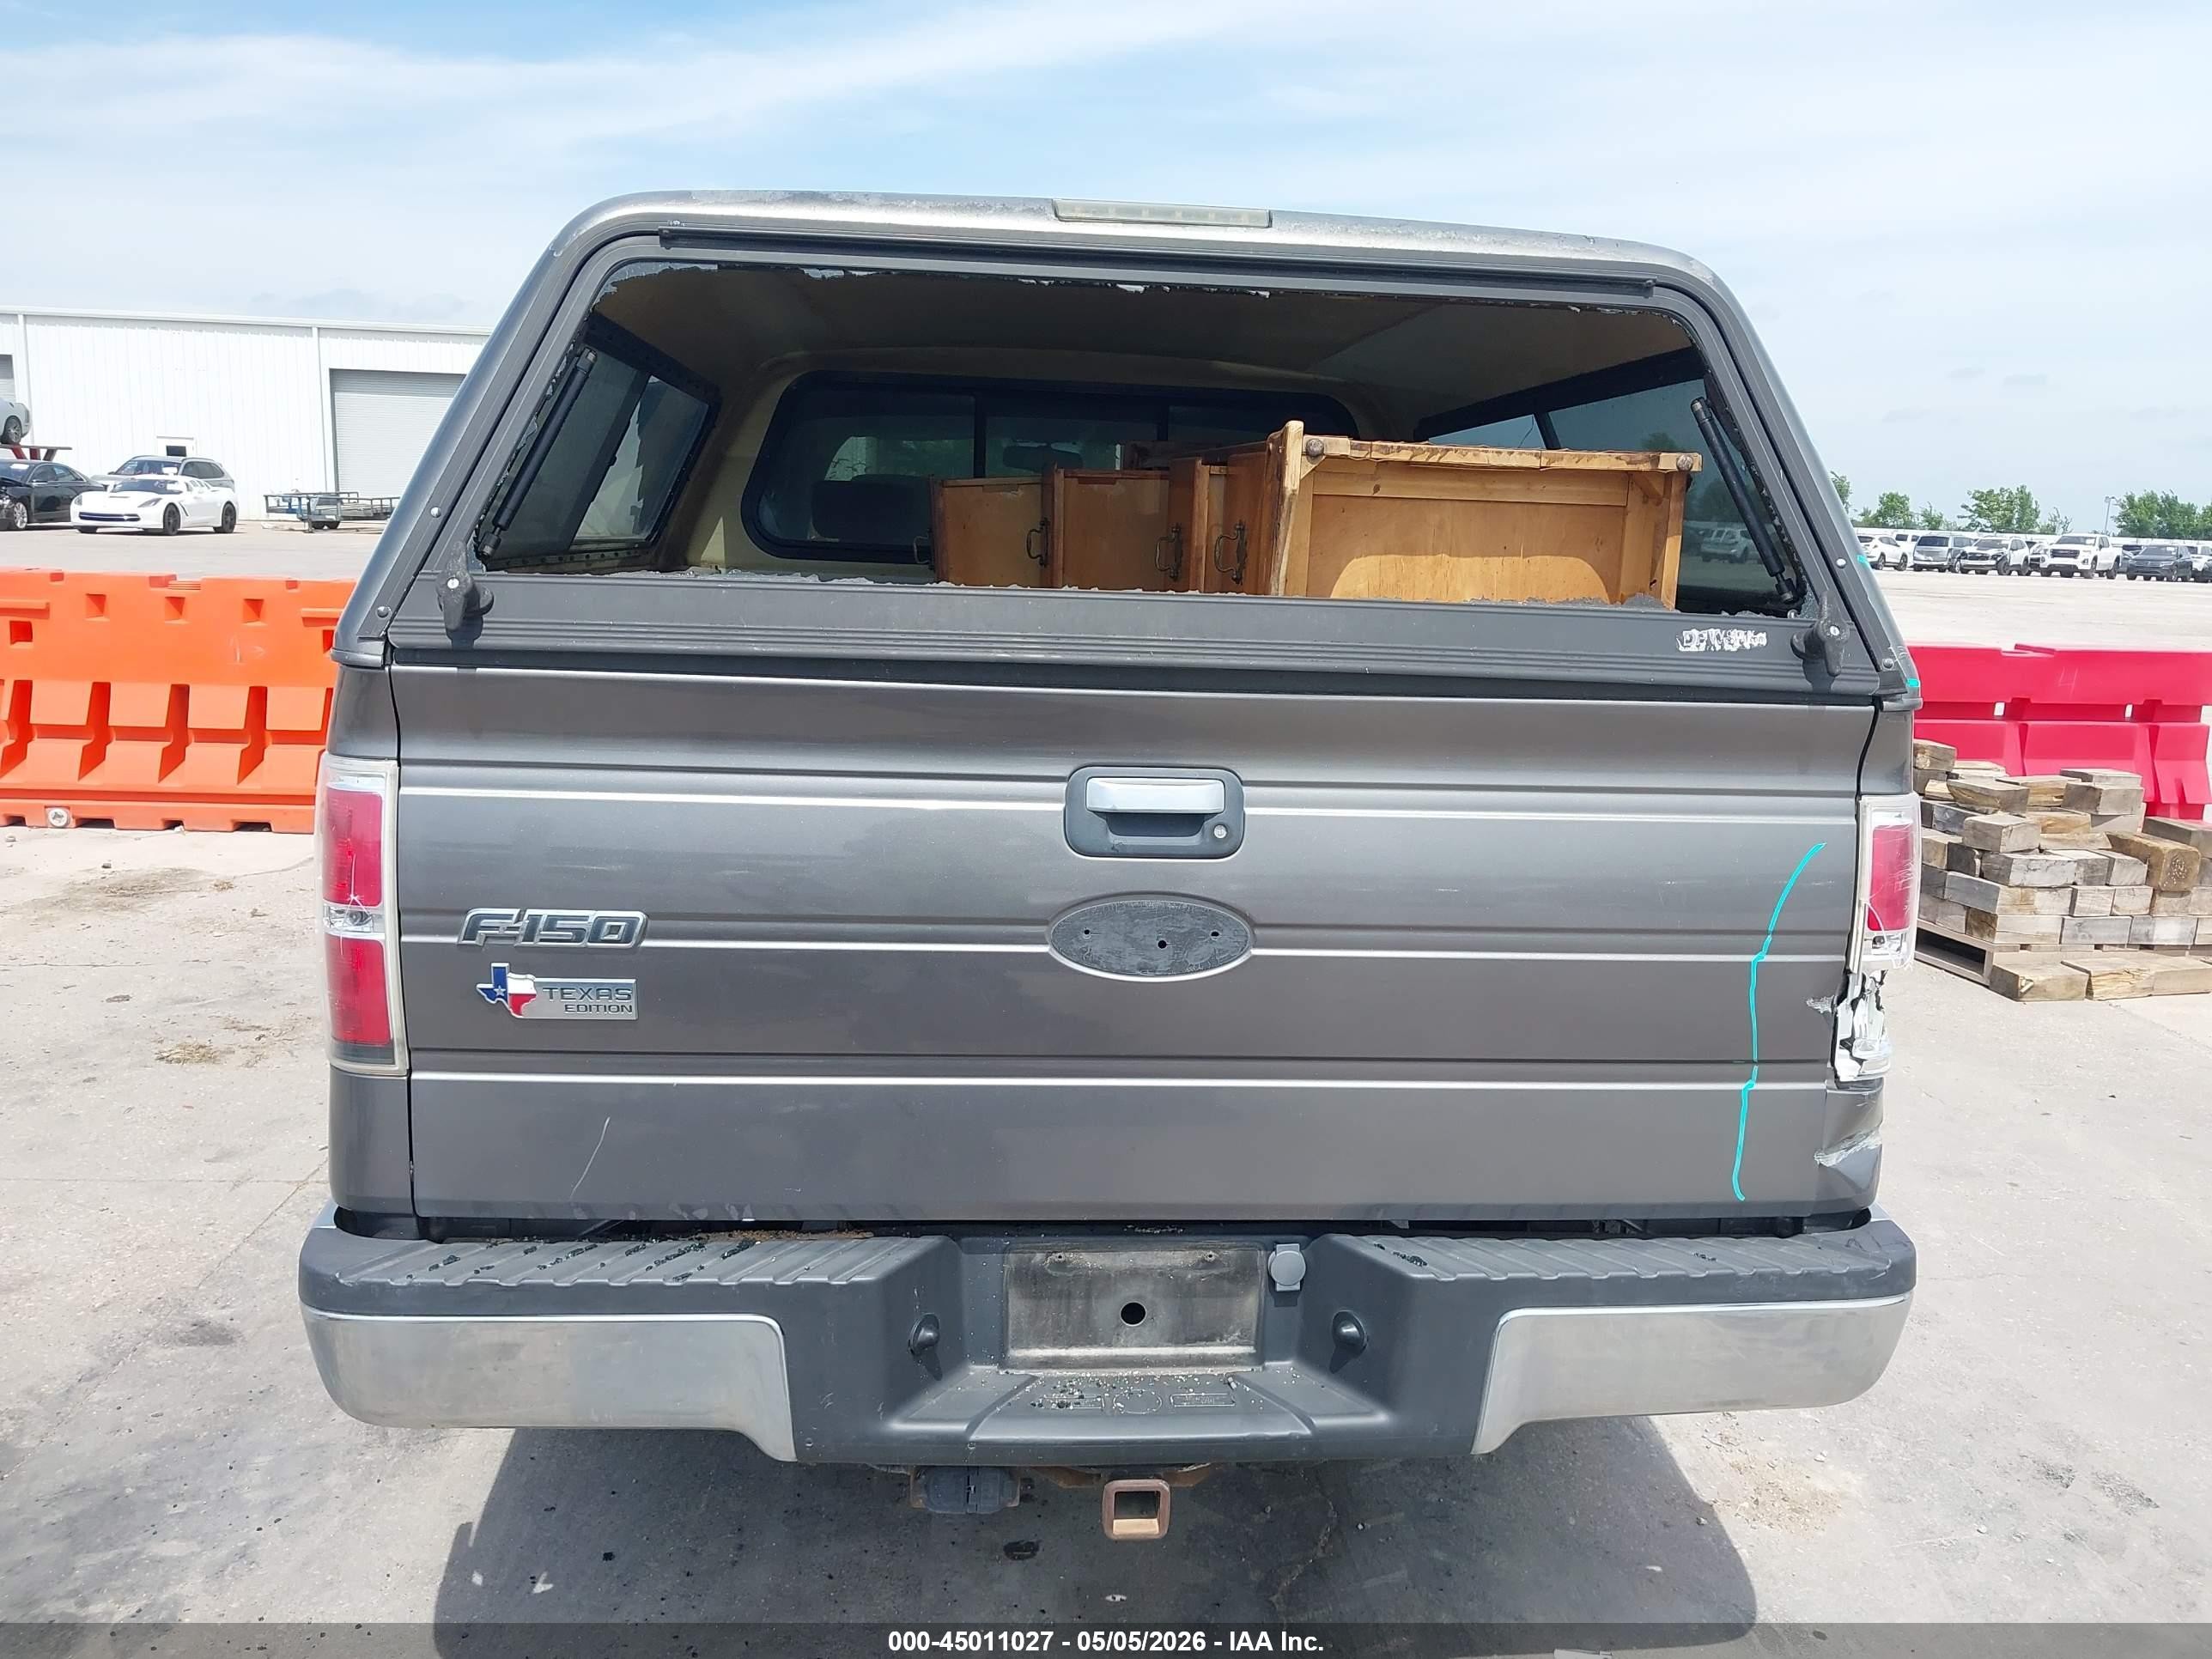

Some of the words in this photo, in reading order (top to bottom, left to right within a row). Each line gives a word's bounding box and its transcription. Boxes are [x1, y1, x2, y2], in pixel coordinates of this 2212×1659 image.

[458, 908, 648, 948] F-150
[543, 988, 632, 1002] TEXAS
[564, 1004, 633, 1015] EDITION
